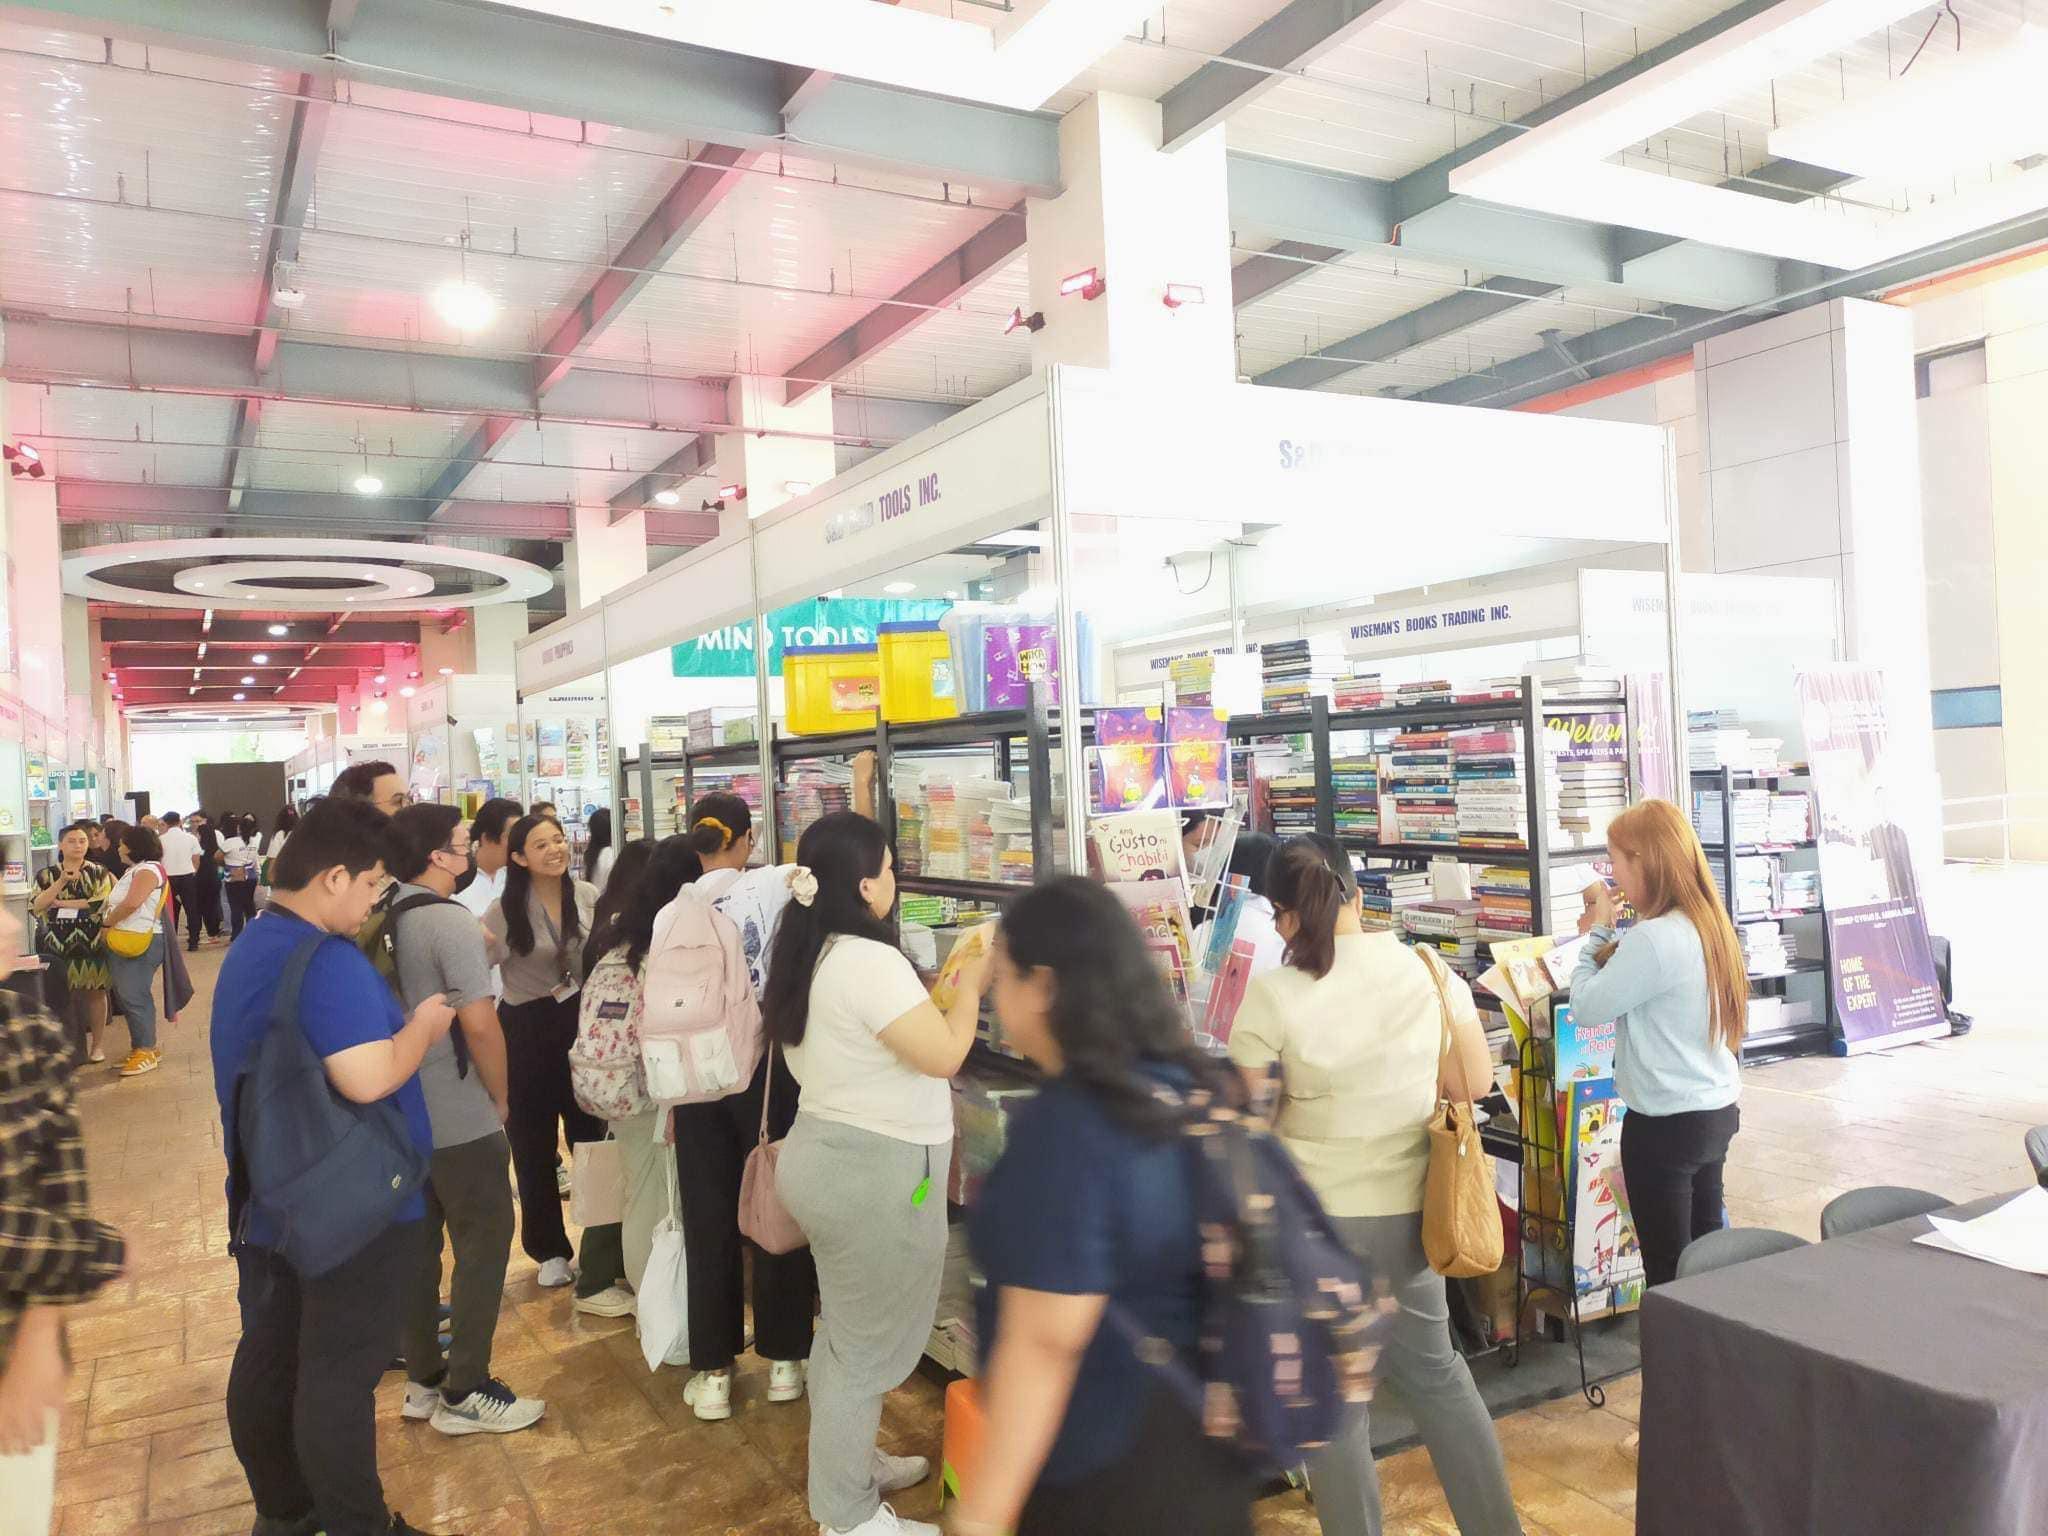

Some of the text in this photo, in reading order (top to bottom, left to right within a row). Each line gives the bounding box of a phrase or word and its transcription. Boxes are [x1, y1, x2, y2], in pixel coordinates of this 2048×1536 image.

[879, 484, 911, 523] TOOLS
[919, 472, 942, 506] INC.
[1350, 604, 1512, 640] WISEMAN'S BOOKS TRADING INC.
[1576, 746, 1610, 756] SPEAKERS
[1840, 956, 1865, 975] HOME
[1842, 973, 1872, 993] OF THE
[1846, 991, 1878, 1012] EXPERT
